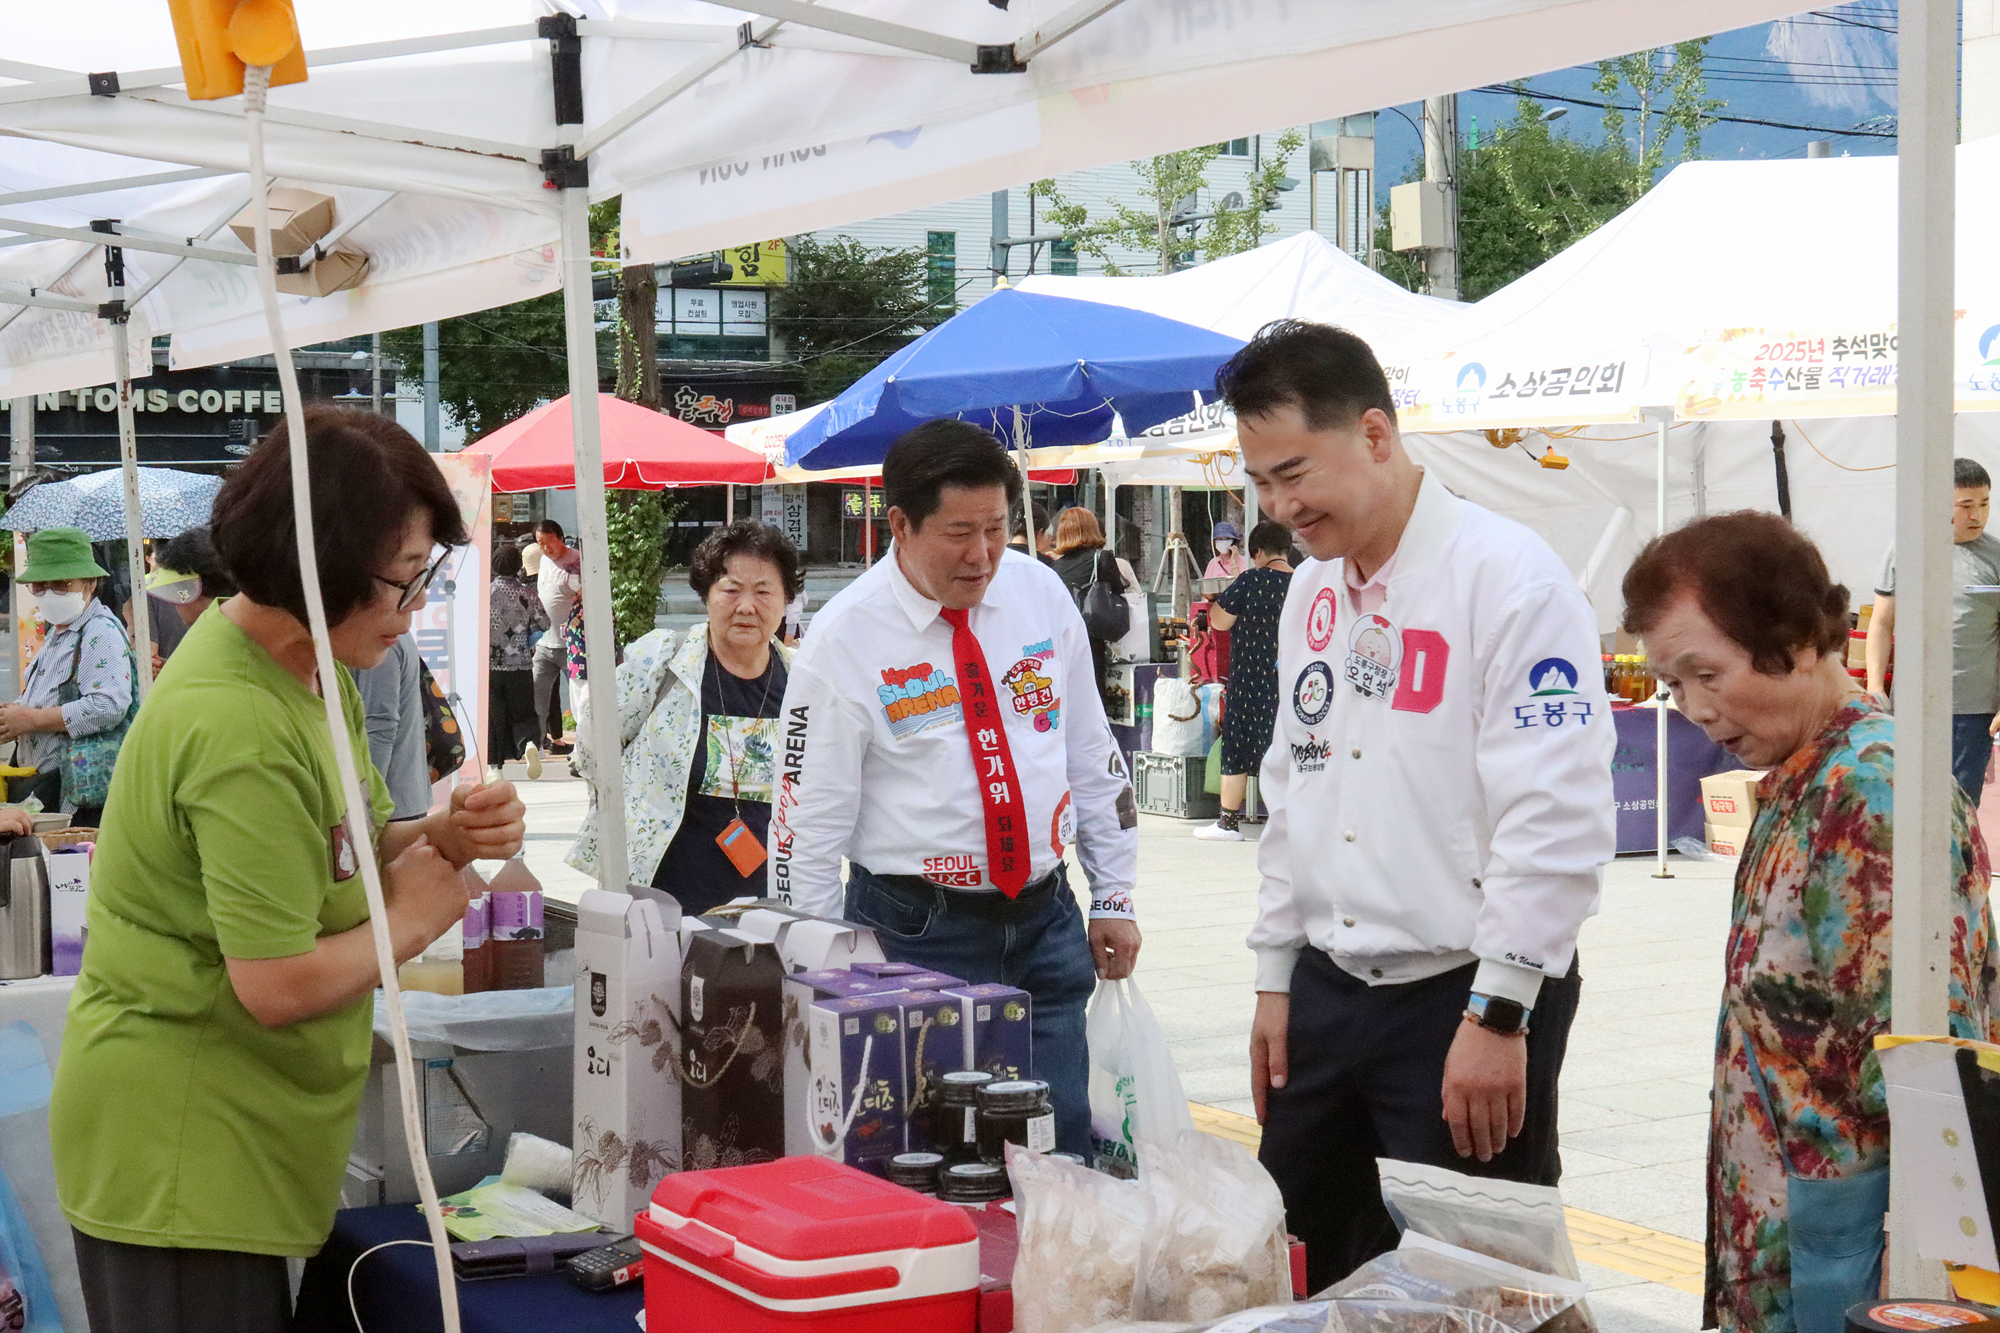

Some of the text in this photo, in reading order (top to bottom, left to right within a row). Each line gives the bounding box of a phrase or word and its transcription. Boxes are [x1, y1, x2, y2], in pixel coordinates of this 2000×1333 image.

[767, 239, 781, 251] 2F
[690, 298, 704, 307] 무료
[731, 299, 758, 309] 영업사원
[738, 309, 751, 319] 모집
[1753, 337, 1825, 364] 2025년
[1487, 360, 1627, 400] 소상공인회
[1730, 363, 1897, 394] 농축수산물 직거래
[178, 389, 287, 414] COFFE
[774, 395, 794, 403] 국내산
[774, 404, 794, 415] 한돈
[1442, 396, 1480, 415] 도봉구
[785, 493, 804, 503] 김치
[1307, 663, 1325, 674] SEOUL
[1354, 655, 1388, 679] 도봉구청장
[1391, 627, 1450, 714] D
[876, 669, 954, 706] SEOUL
[964, 661, 989, 718] 즐거운
[1347, 666, 1388, 697] 오언석
[885, 684, 962, 723] ARENA
[1014, 687, 1052, 711] 안병건
[1033, 709, 1059, 733] GT
[1294, 701, 1331, 724] DOBONG SOCKS
[1514, 701, 1595, 729] 도봉구
[783, 705, 810, 786] ARENA
[976, 727, 1011, 805] 한가위
[923, 854, 979, 872] SEOUL
[1504, 952, 1518, 962] Oh
